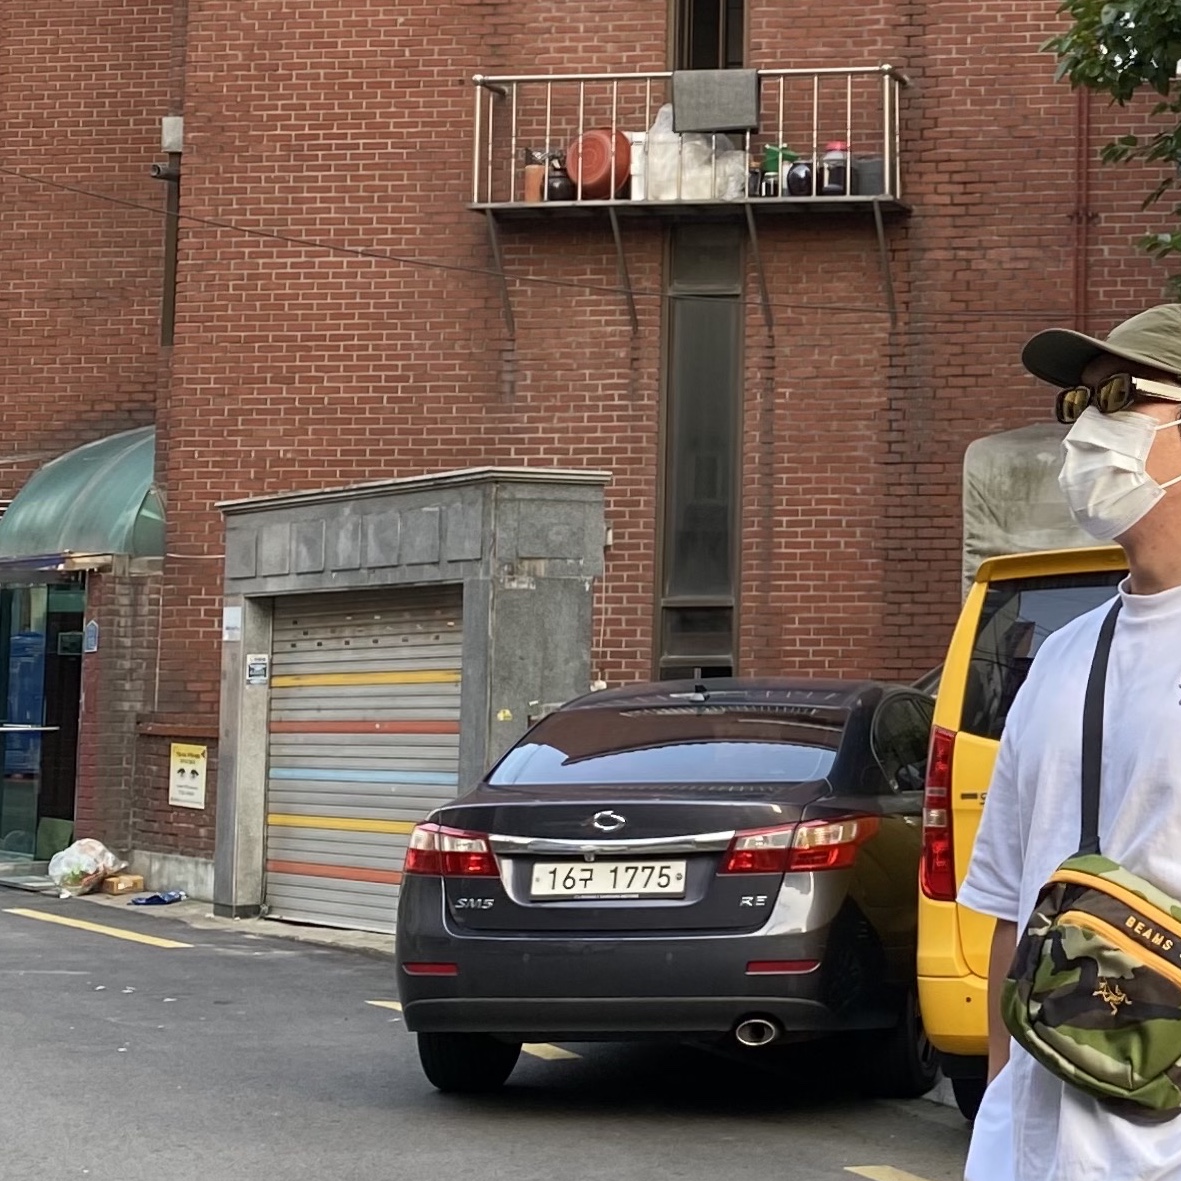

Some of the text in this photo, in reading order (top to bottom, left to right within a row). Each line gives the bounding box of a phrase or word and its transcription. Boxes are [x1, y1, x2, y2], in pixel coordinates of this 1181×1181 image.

[548, 865, 672, 890] 16구 1775
[454, 897, 495, 909] SM5
[740, 895, 768, 907] RE
[1125, 915, 1174, 951] BEAMS
